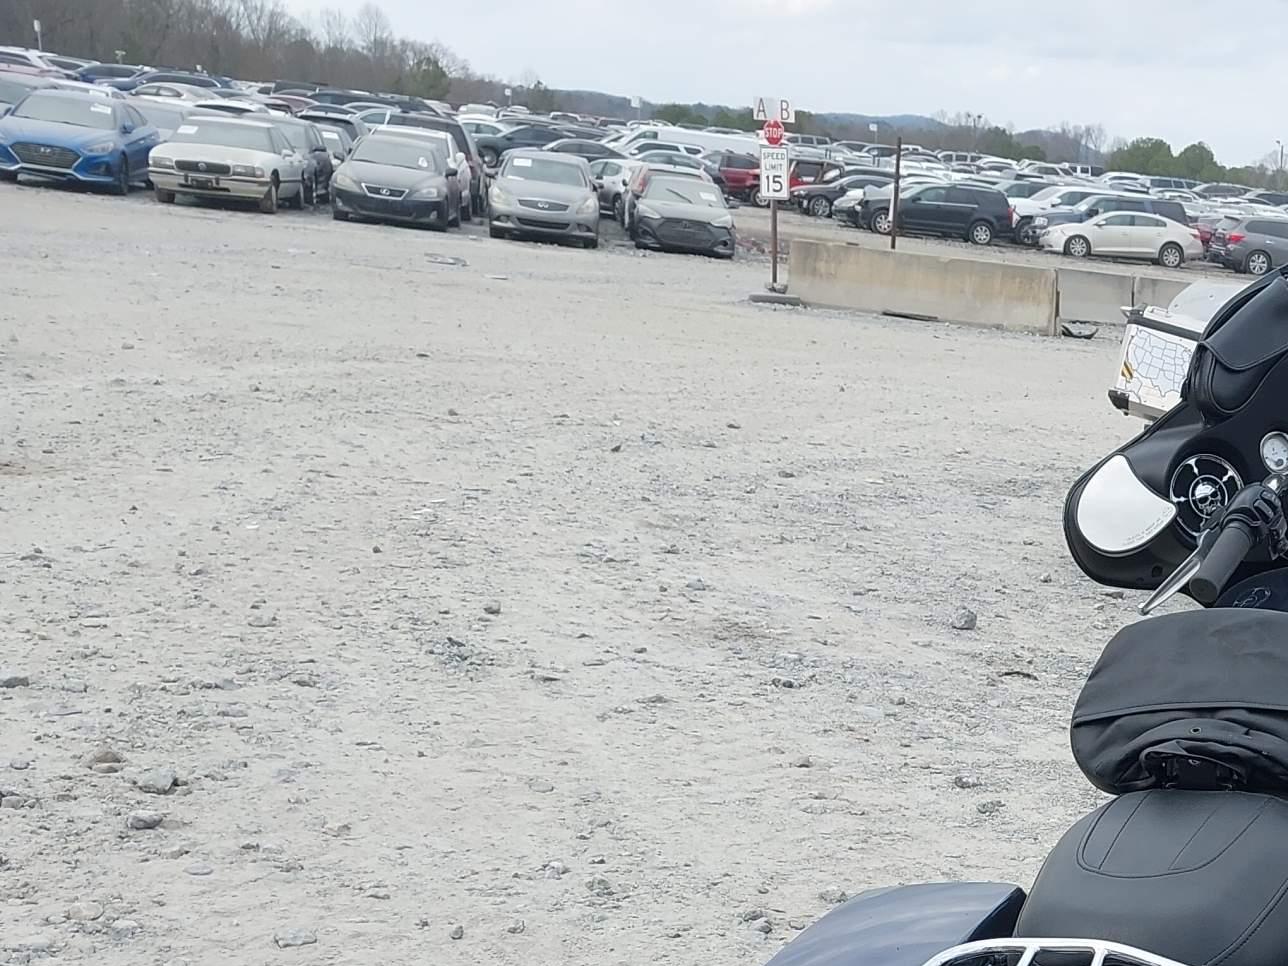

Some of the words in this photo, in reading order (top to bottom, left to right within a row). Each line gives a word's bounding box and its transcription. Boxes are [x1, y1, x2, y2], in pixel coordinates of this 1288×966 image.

[756, 97, 767, 119] A
[780, 99, 790, 121] B
[764, 127, 783, 138] STOP
[763, 152, 785, 160] SPEED
[764, 163, 783, 171] LIMIT
[766, 175, 783, 193] 15
